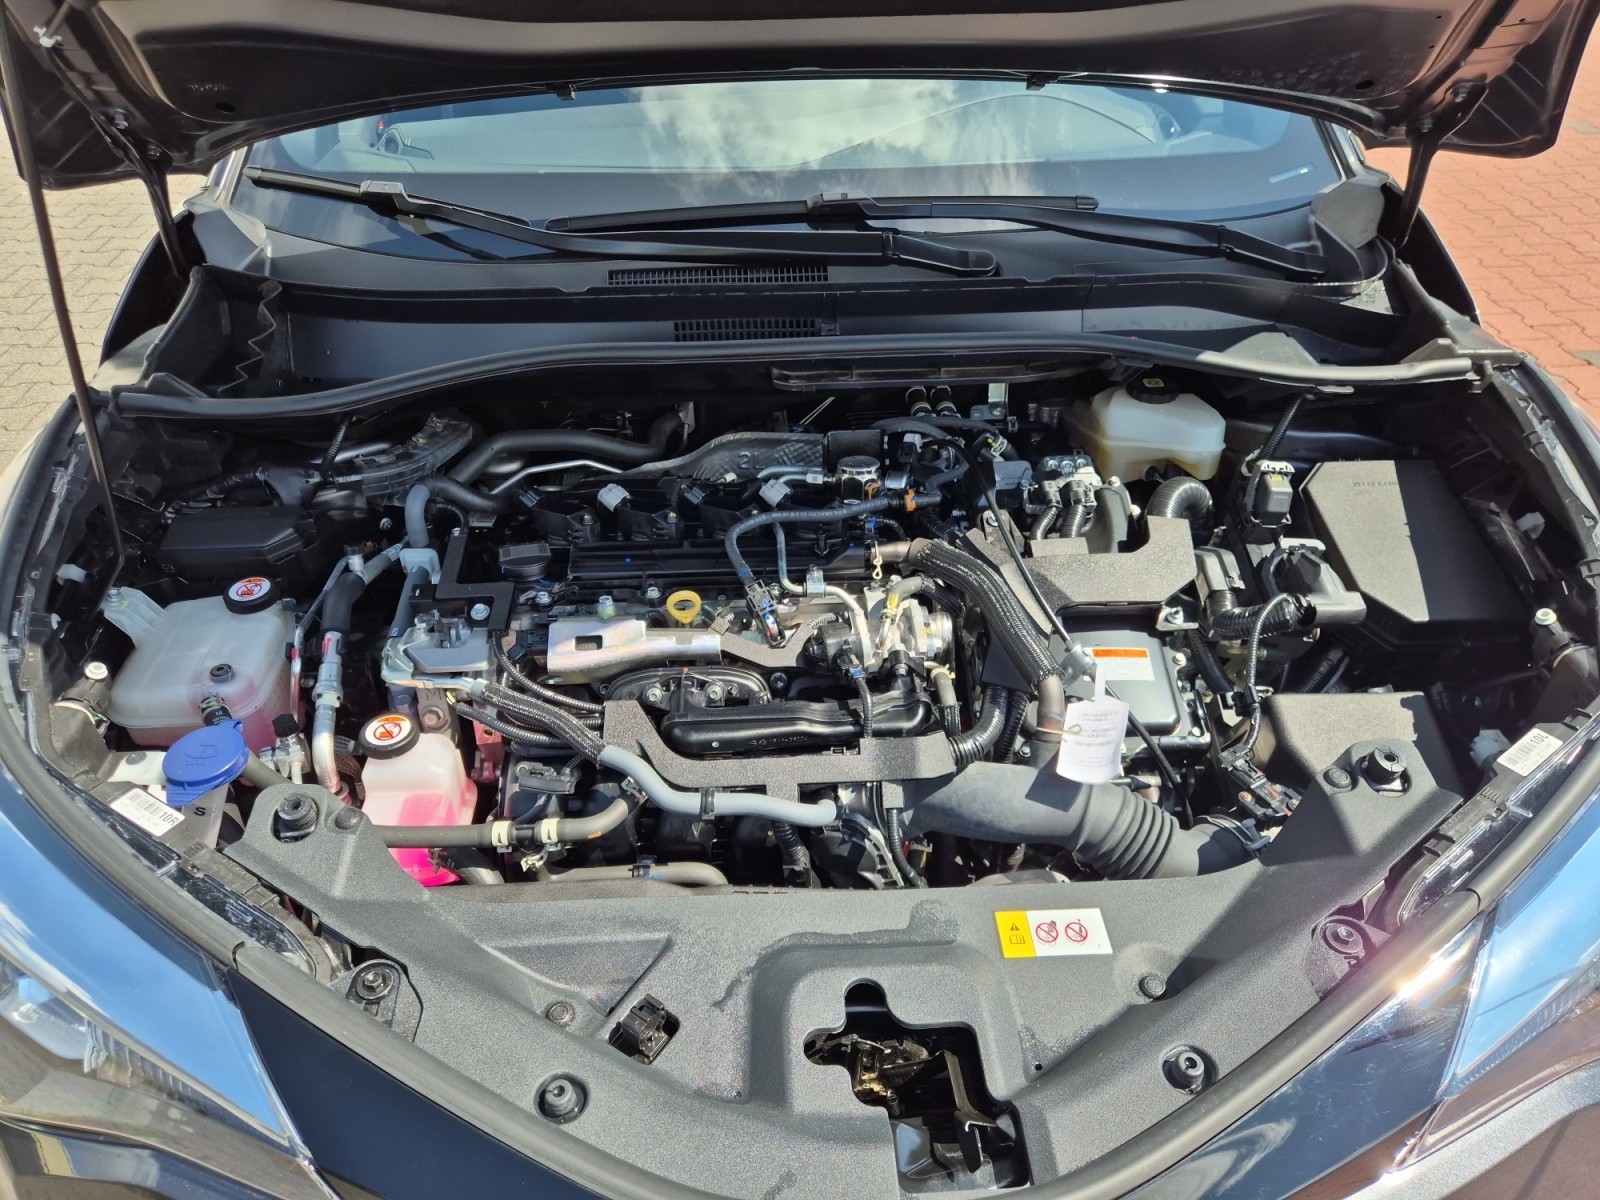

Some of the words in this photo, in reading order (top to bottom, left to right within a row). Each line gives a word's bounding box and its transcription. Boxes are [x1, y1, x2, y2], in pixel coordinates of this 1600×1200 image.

[738, 451, 766, 470] 2L
[1530, 732, 1549, 745] 10L
[158, 811, 180, 826] 10R
[193, 806, 206, 817] S
